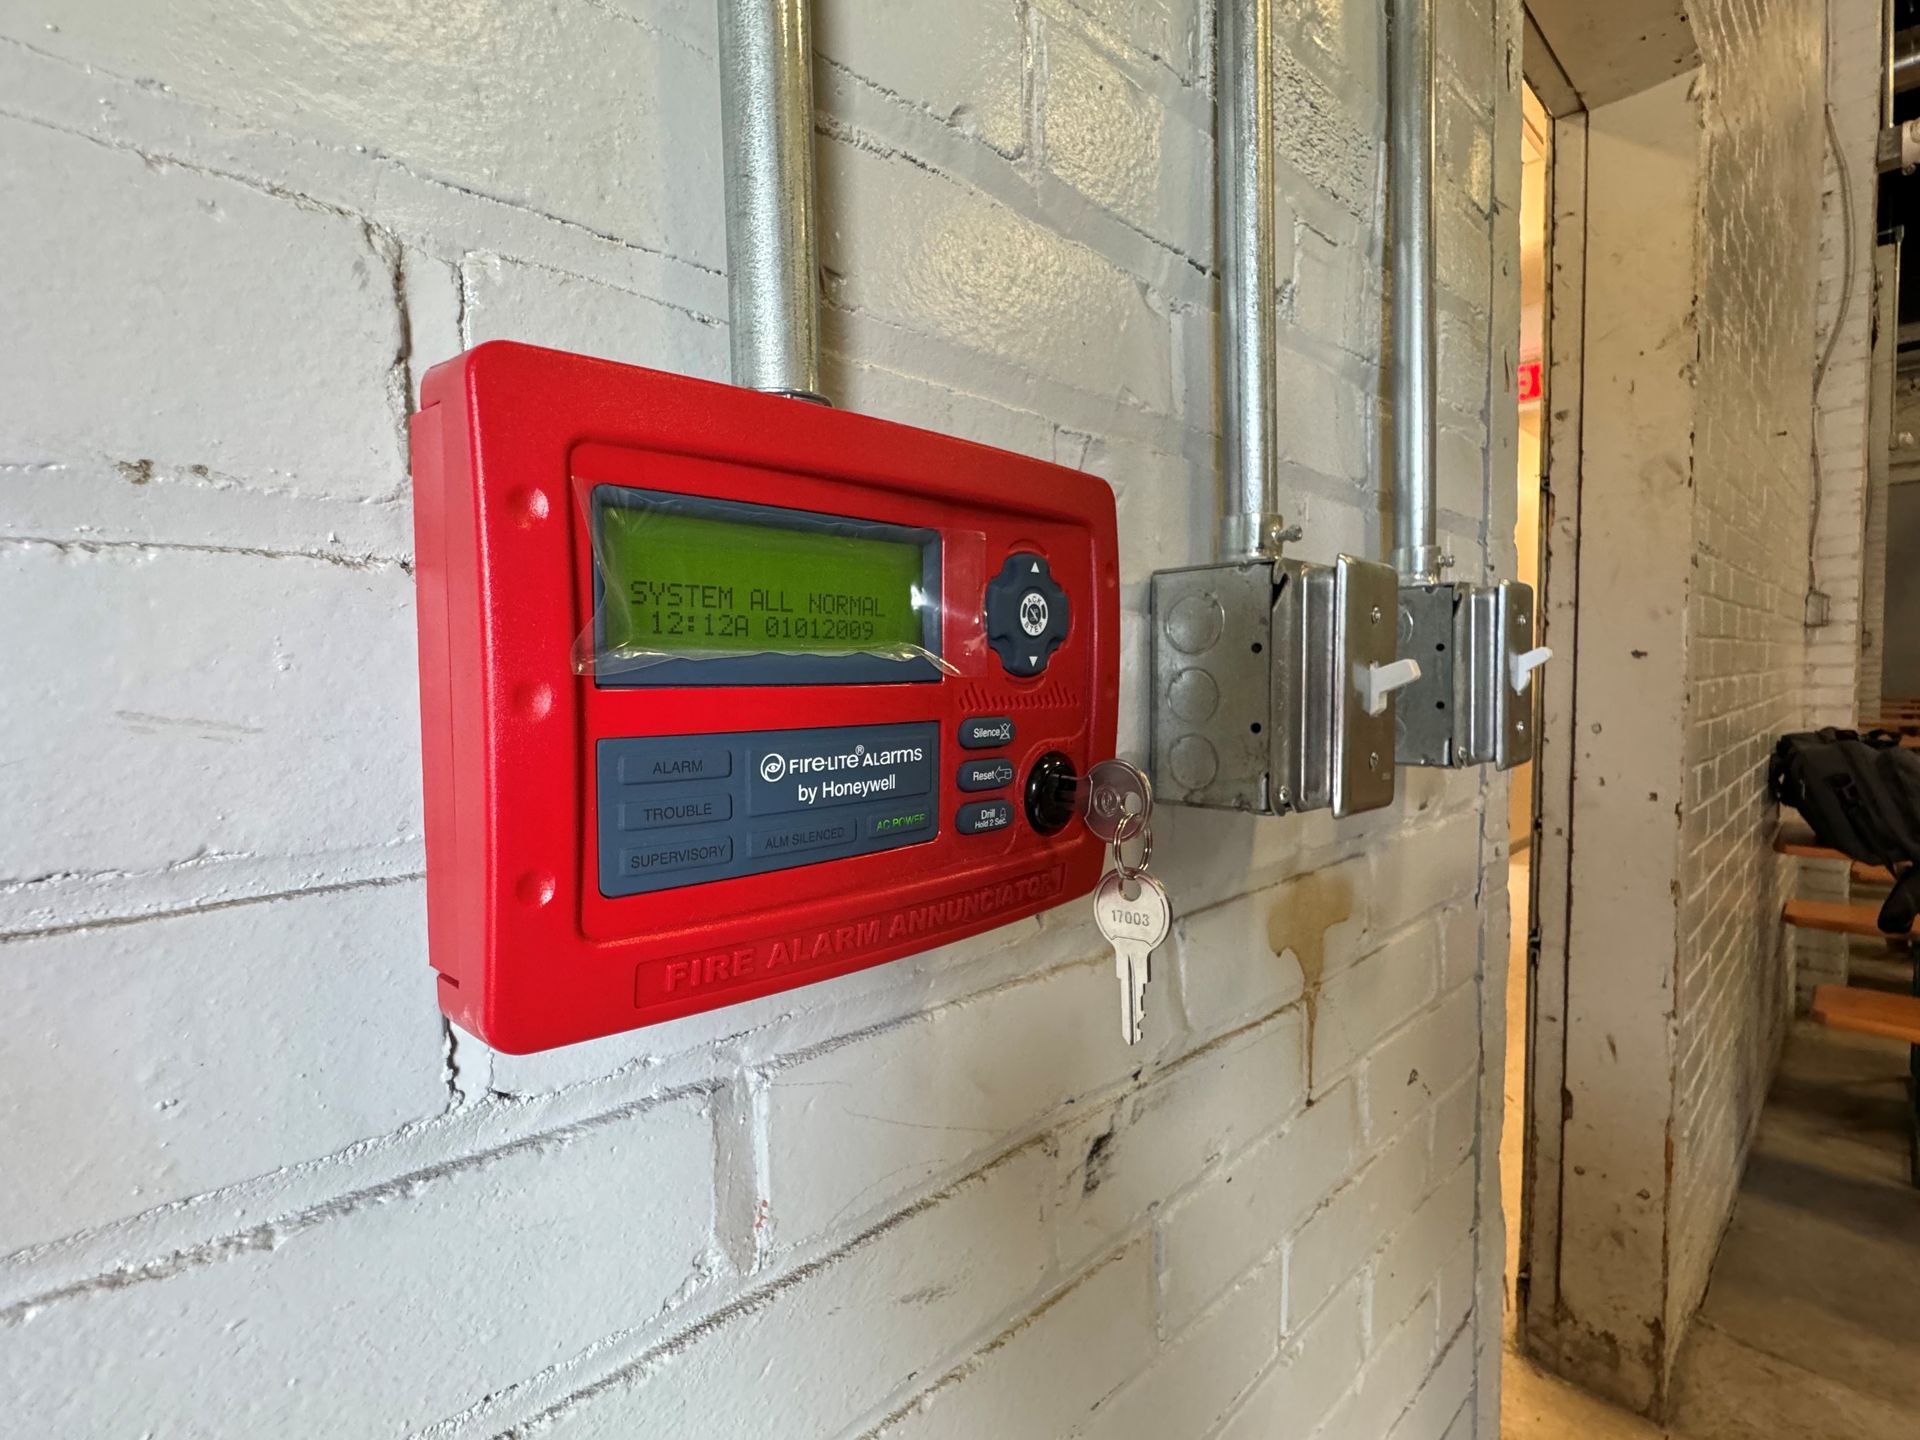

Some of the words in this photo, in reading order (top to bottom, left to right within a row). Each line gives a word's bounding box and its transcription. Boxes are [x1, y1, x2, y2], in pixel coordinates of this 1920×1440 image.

[630, 580, 733, 610] SYSTEM
[750, 590, 793, 613] ALL
[808, 593, 886, 617] NORMAL
[652, 612, 749, 637] 12:12A
[765, 617, 874, 641] 01012009
[973, 727, 1001, 739] Silence
[652, 760, 703, 774] ALARM
[972, 770, 995, 781] Reset
[798, 784, 818, 804] by
[822, 774, 896, 798] Honeywell
[643, 803, 712, 822] TROUBLE
[981, 809, 996, 819] Drill
[974, 820, 989, 829] Hold
[765, 837, 789, 849] ALM
[791, 827, 845, 845] SILENCED
[630, 846, 726, 869] SUPERVISORY
[1111, 909, 1150, 927] 17003
[665, 948, 756, 993] FIRE
[767, 920, 881, 969] ALARM
